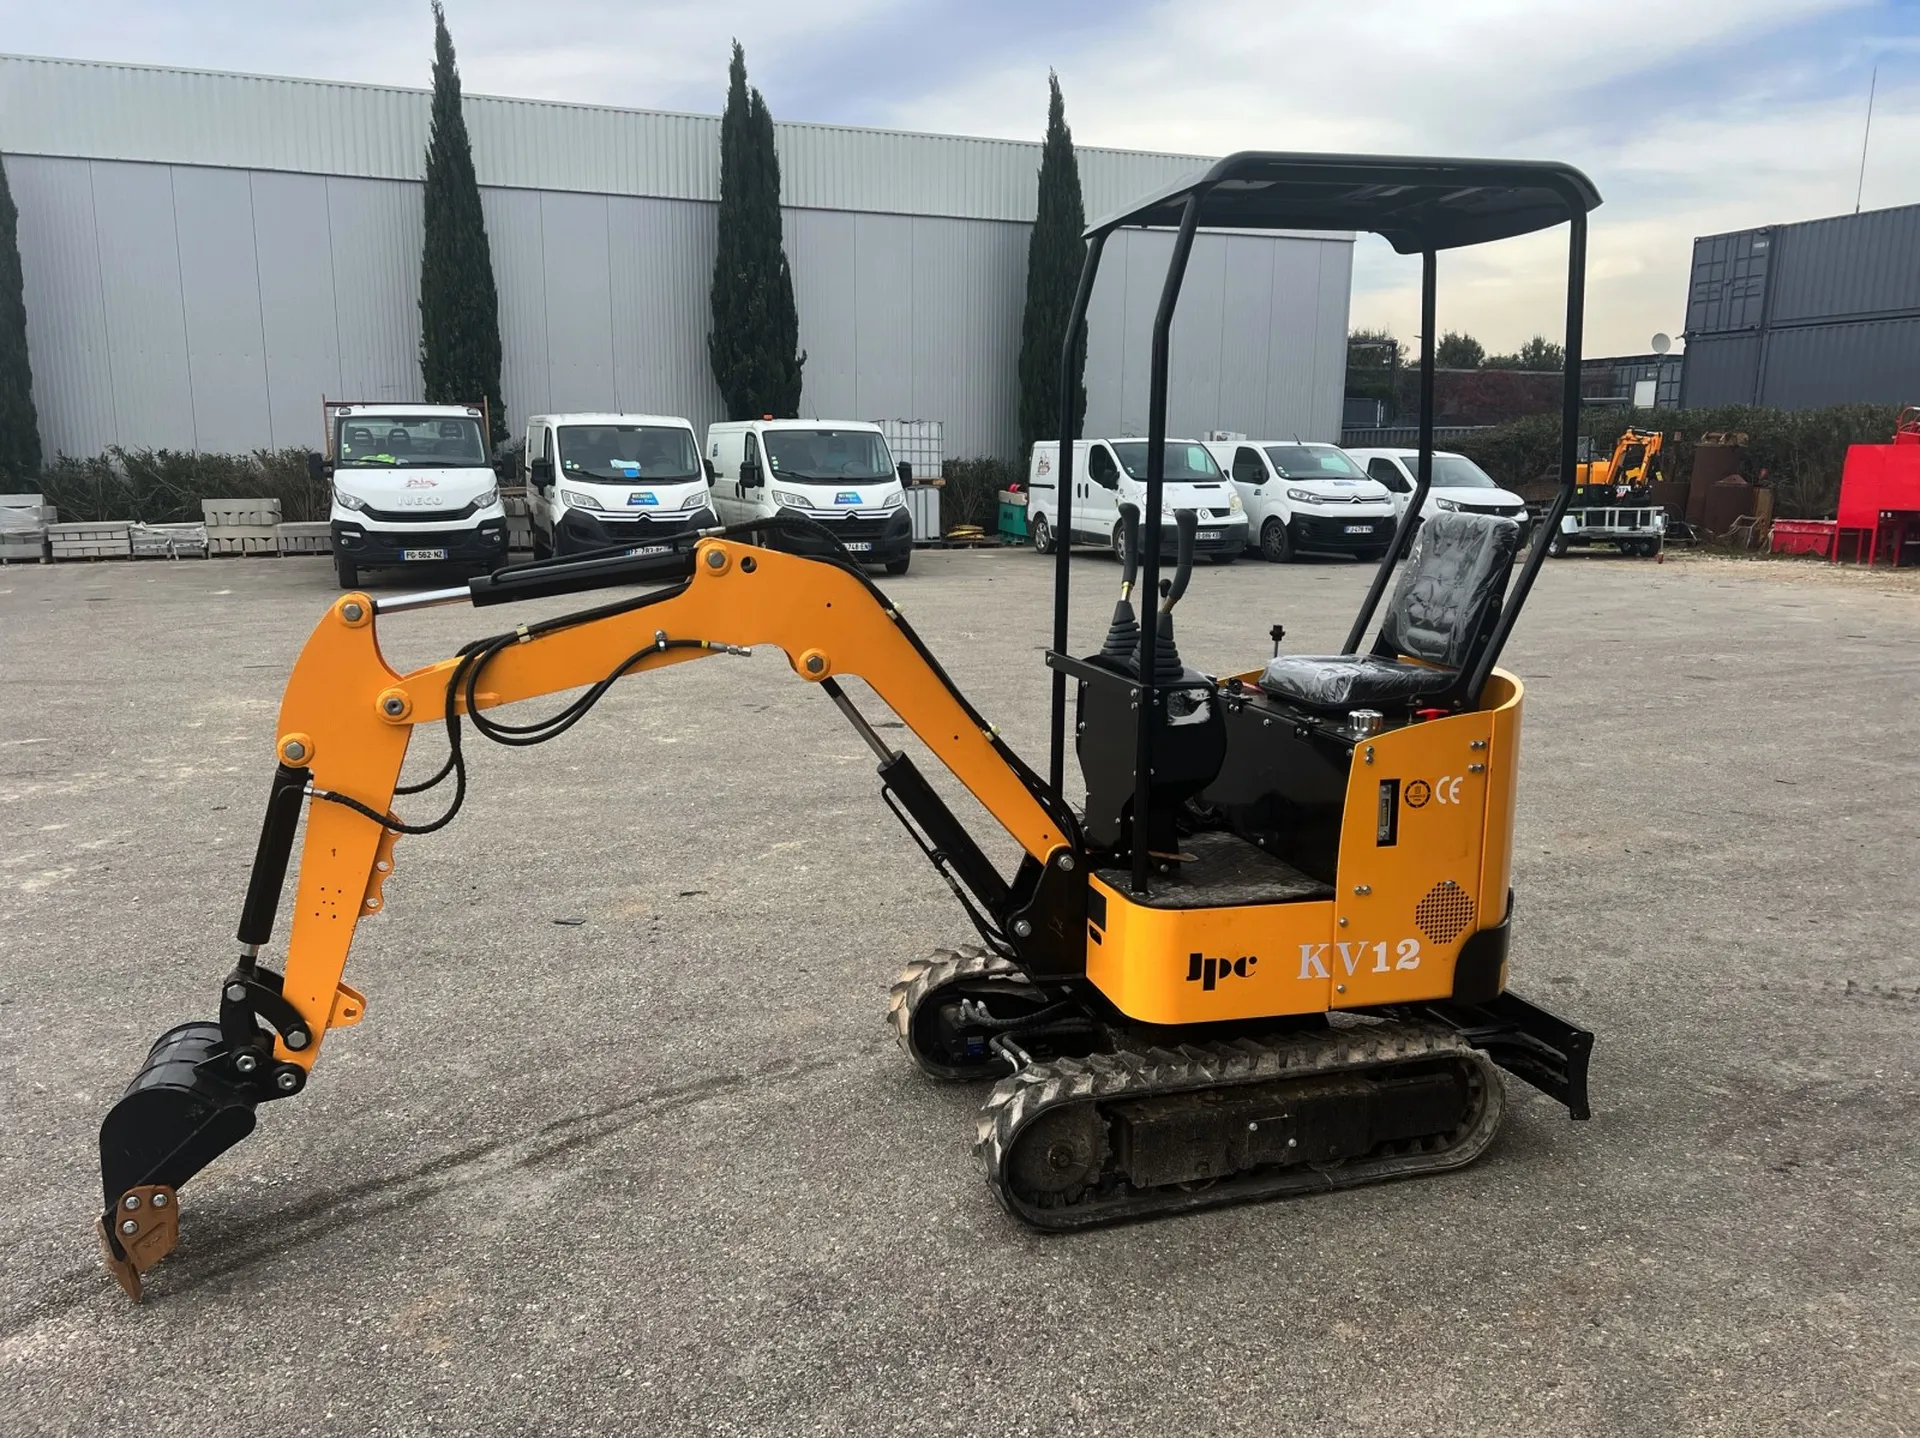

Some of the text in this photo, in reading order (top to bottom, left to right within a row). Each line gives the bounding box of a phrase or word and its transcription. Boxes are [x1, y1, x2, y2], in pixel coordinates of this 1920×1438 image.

[397, 495, 444, 506] IVECO
[1435, 775, 1464, 805] CE
[1296, 939, 1421, 980] KV12
